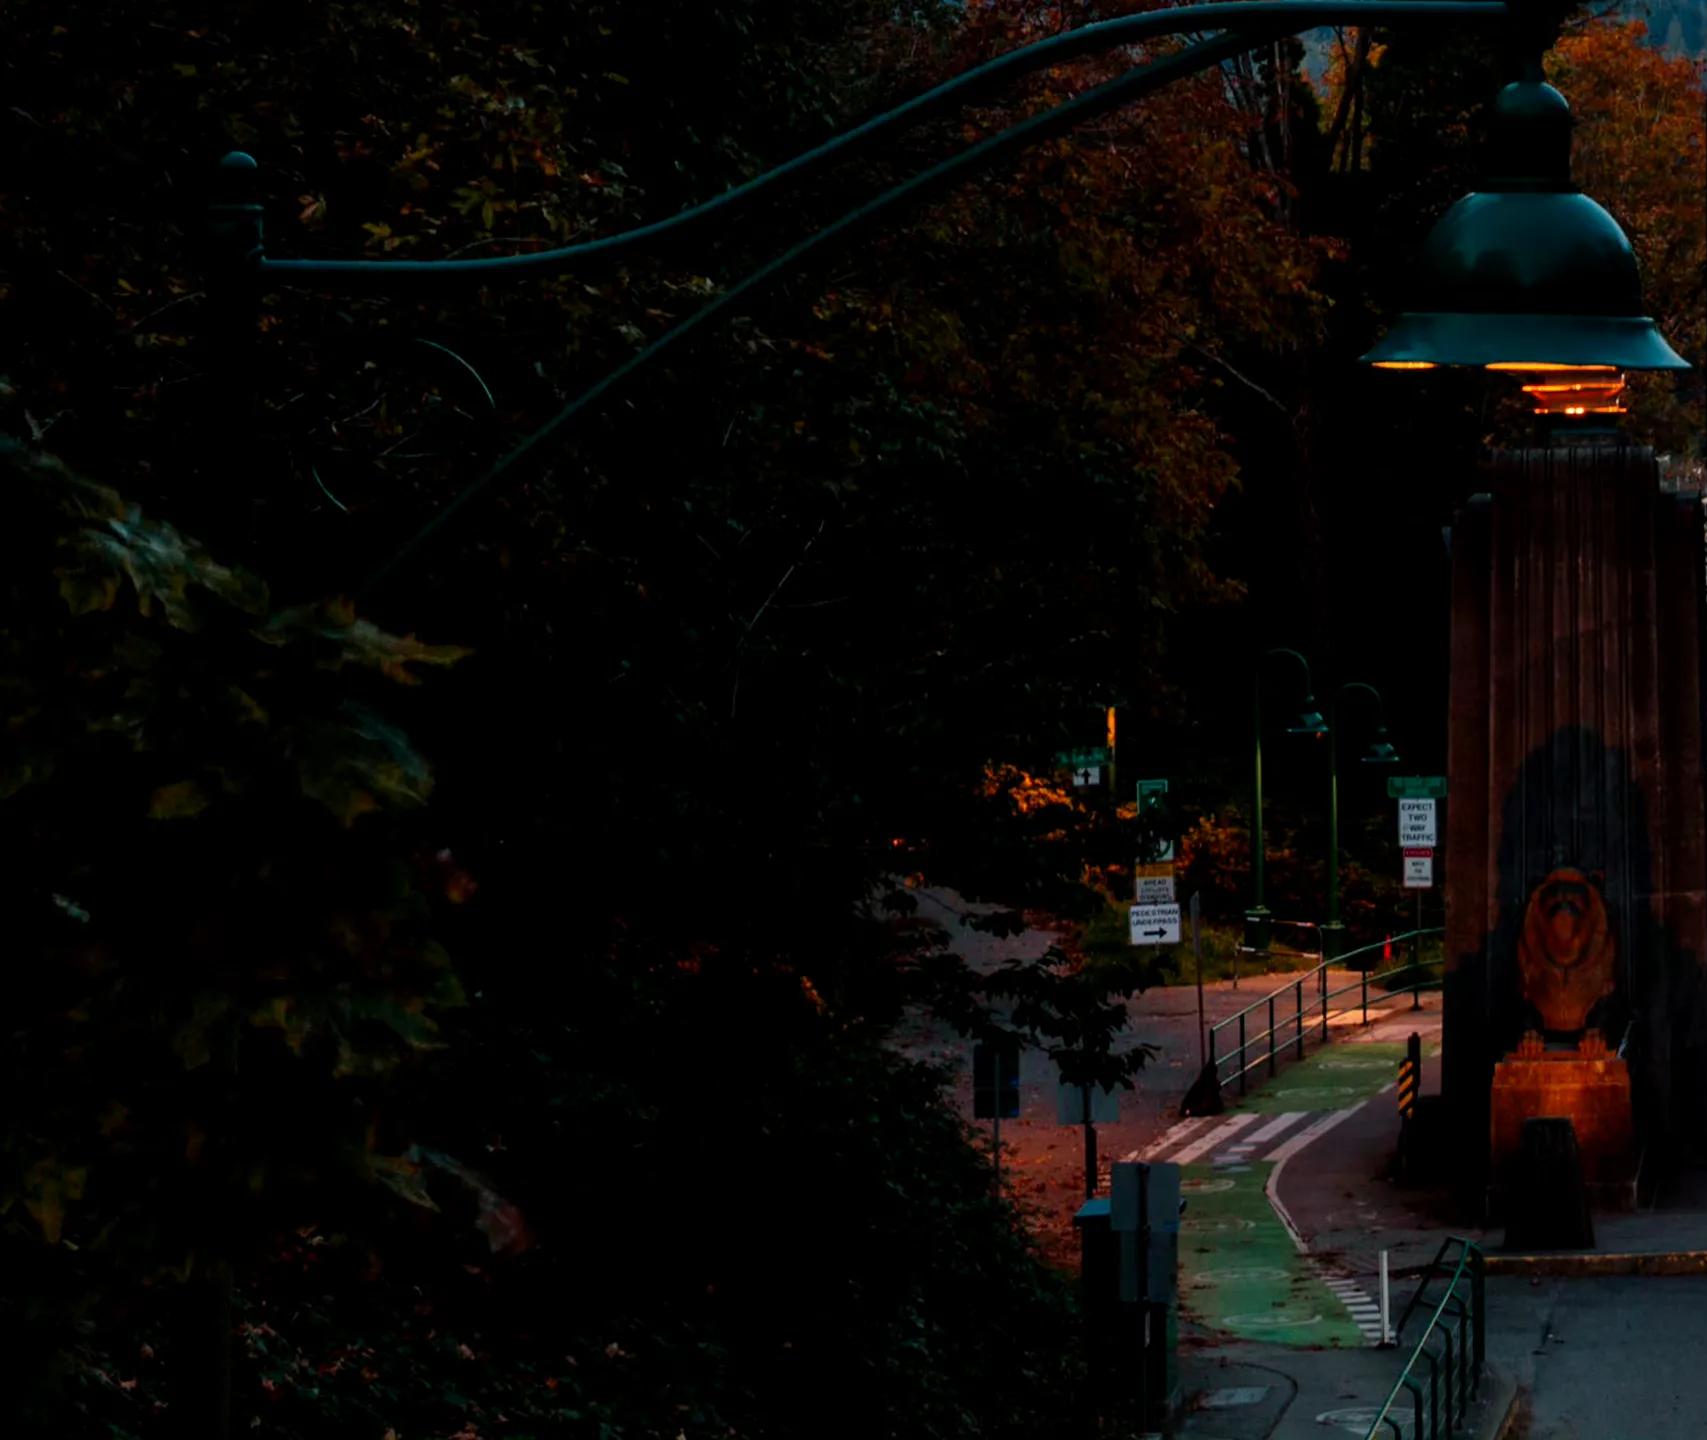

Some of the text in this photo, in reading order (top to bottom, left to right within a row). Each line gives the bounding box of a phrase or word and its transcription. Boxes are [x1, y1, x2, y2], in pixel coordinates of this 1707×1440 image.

[1402, 803, 1433, 811] EXPECT
[1408, 813, 1427, 821] TWO
[1402, 833, 1433, 841] TRAFFIC
